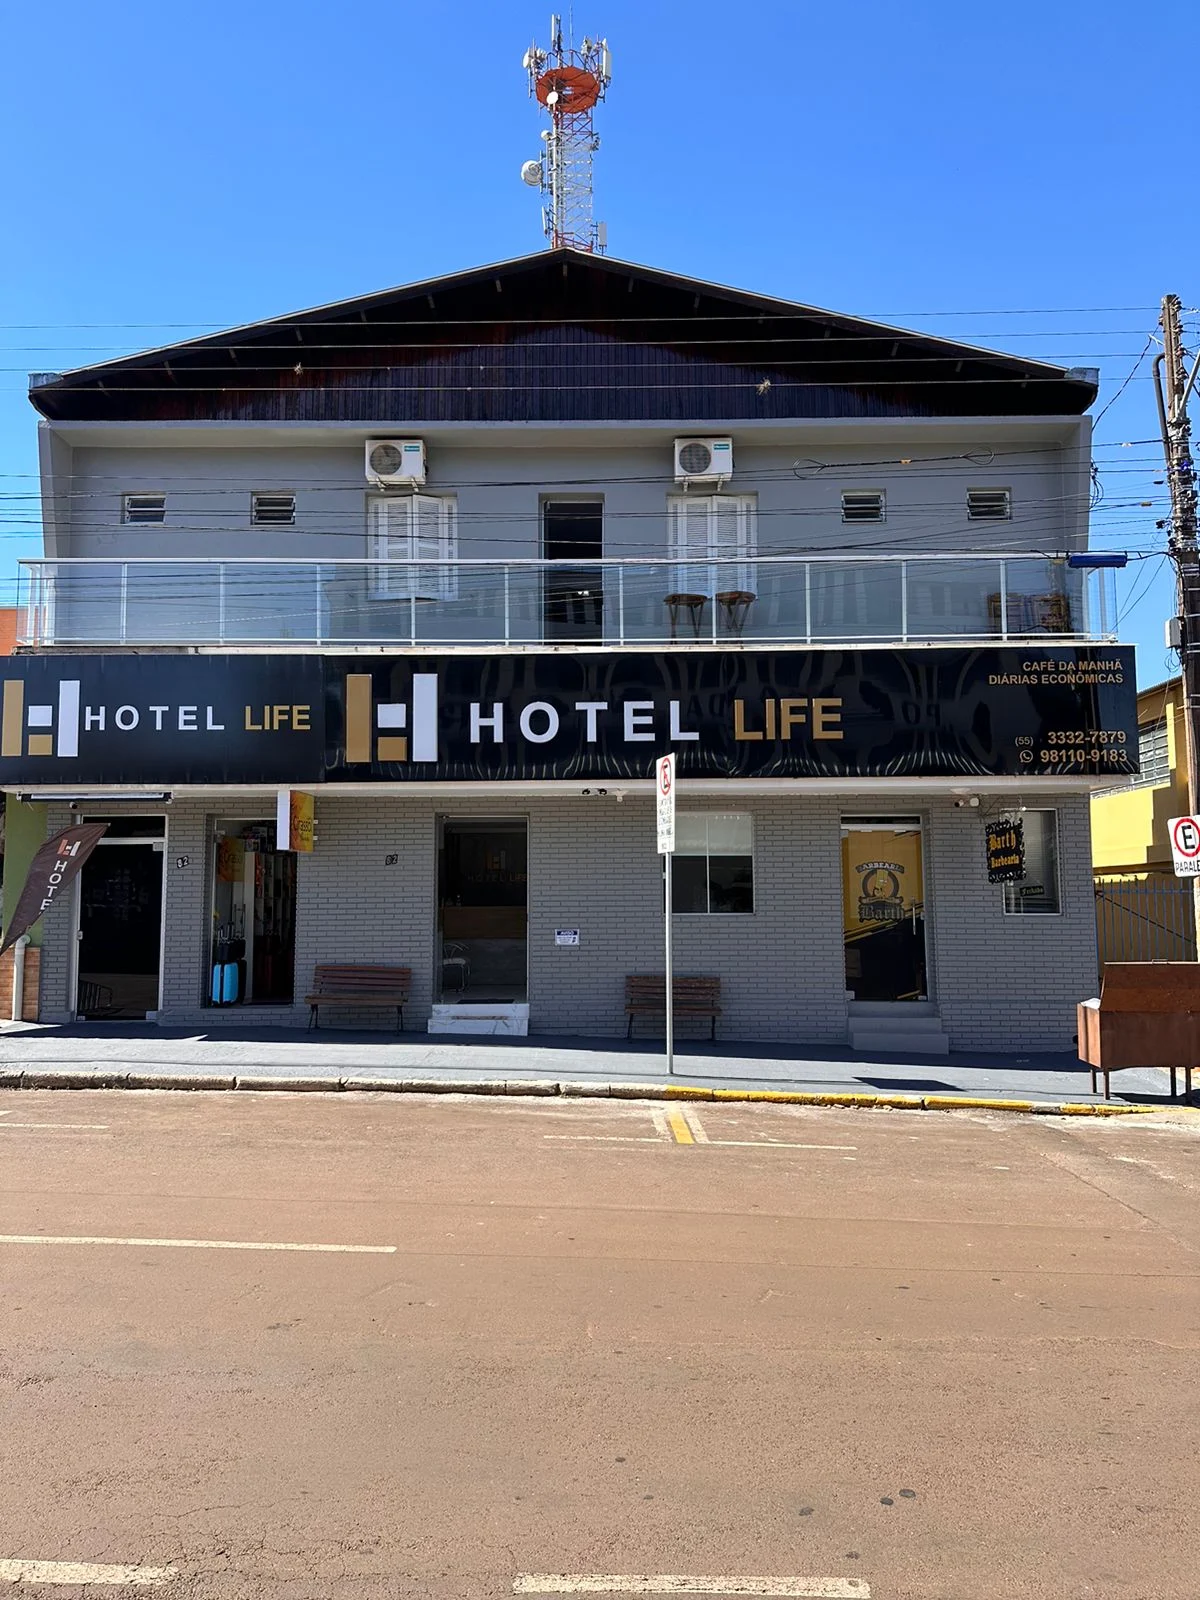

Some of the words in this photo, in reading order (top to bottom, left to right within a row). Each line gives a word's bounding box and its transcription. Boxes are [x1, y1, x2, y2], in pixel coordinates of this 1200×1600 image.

[1022, 659, 1056, 672] CAFÉ
[1058, 660, 1077, 671] DA
[1078, 659, 1123, 671] MANHÃ
[988, 672, 1038, 685] DIÁRIAS
[1041, 672, 1124, 684] ECONÔMICAS
[84, 705, 225, 731] HOTEL
[244, 705, 311, 731] LIFE
[469, 701, 700, 743] HOTEL
[734, 698, 844, 740] LIFE
[1015, 736, 1034, 747] (55)
[1047, 731, 1127, 744] 3332-7879
[1040, 749, 1128, 762] 98110-9183
[989, 829, 1016, 850] Barth
[1182, 824, 1195, 849] E
